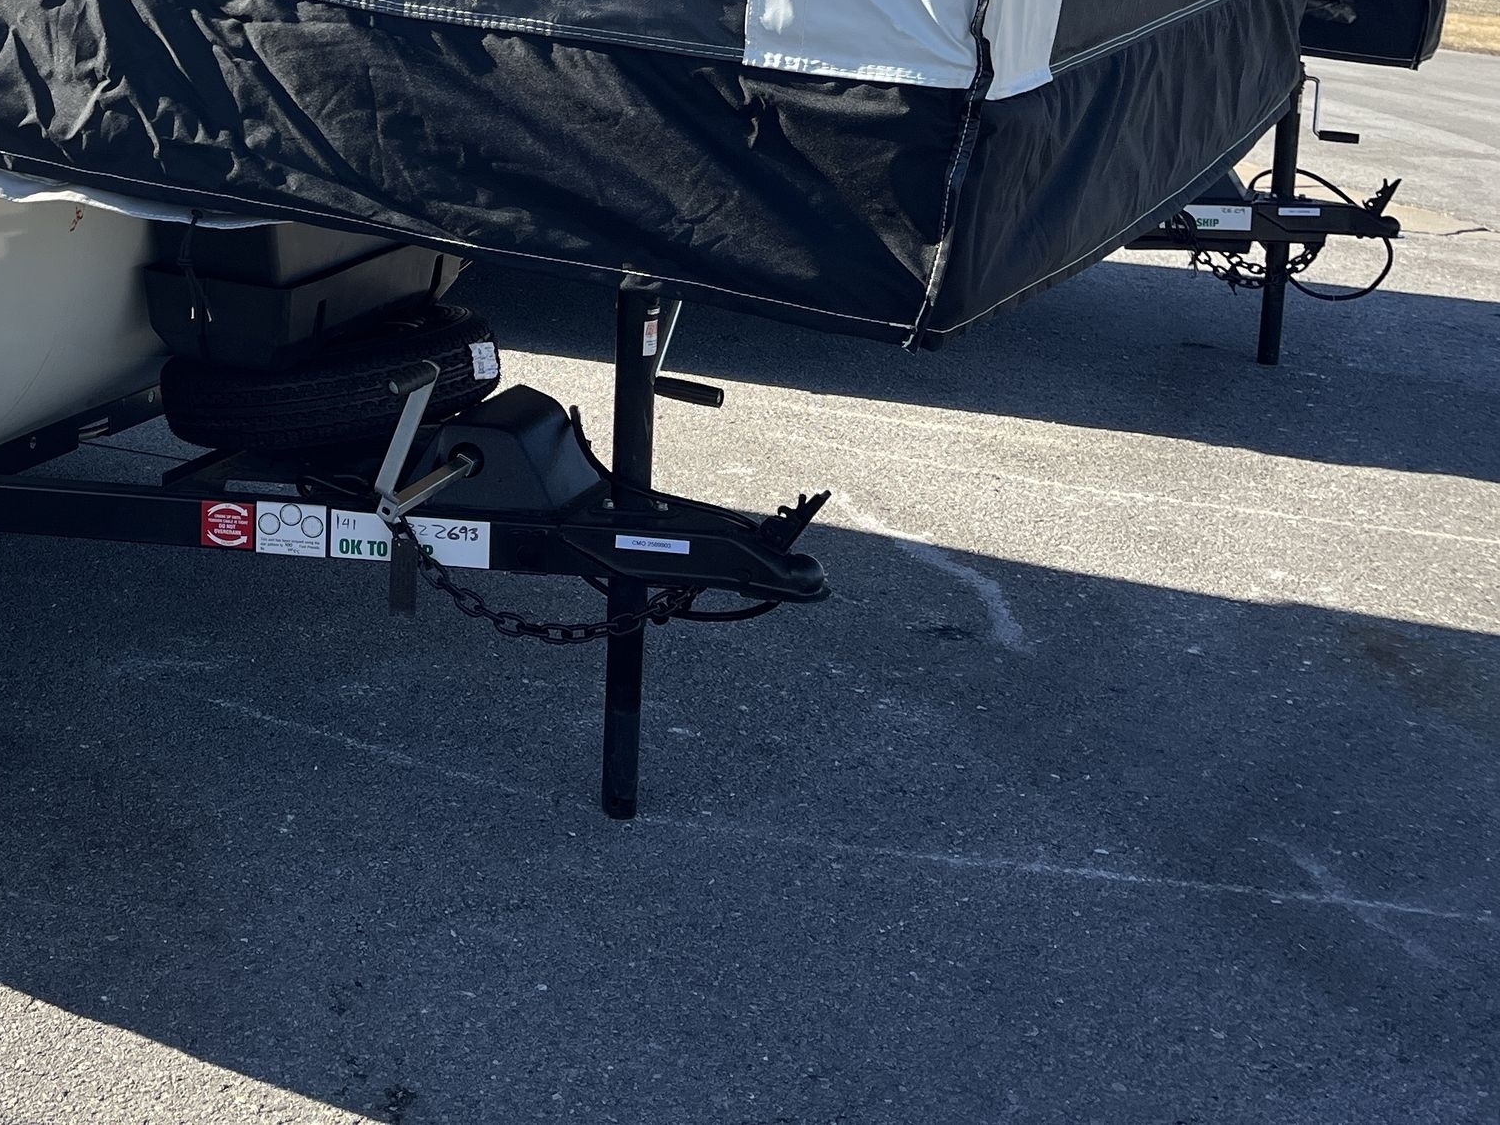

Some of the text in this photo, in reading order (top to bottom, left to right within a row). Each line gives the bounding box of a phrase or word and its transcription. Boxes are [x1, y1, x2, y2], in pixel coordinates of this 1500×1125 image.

[1196, 217, 1220, 228] SHIP
[336, 514, 356, 531] 141
[339, 538, 388, 557] OK TO
